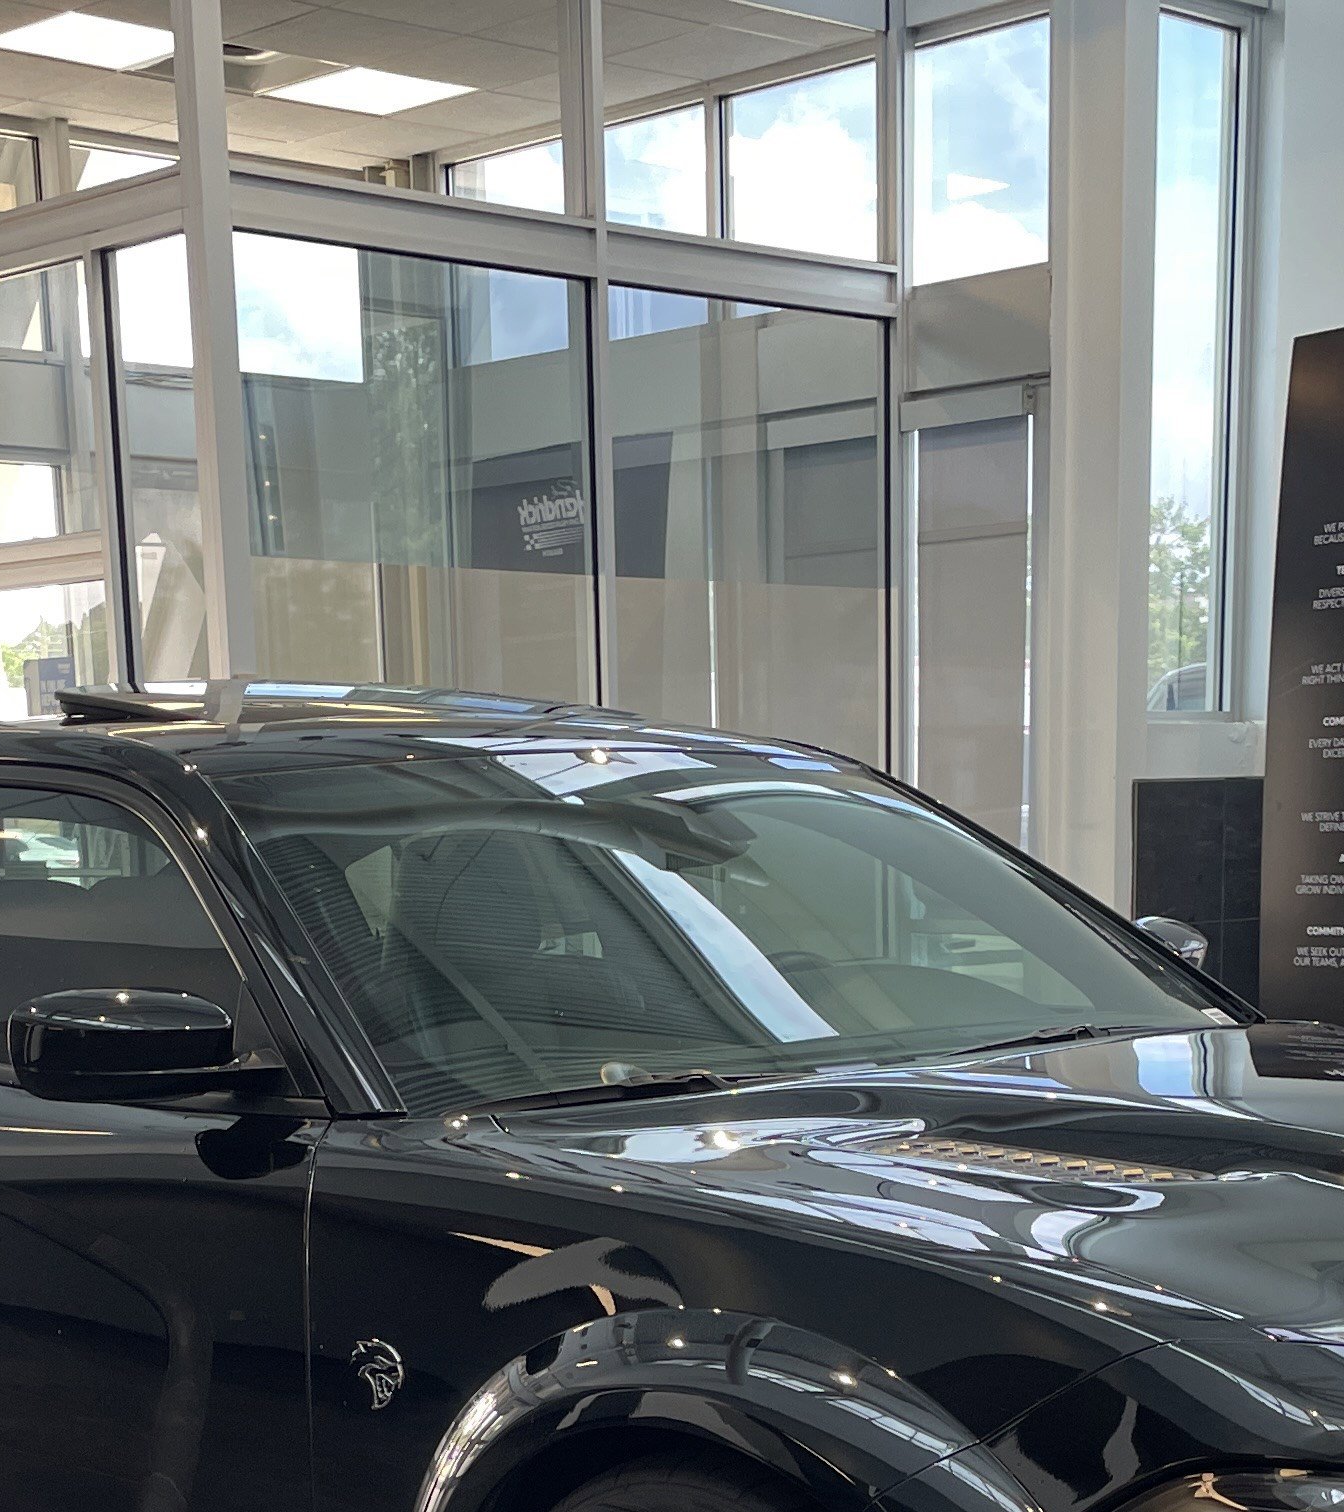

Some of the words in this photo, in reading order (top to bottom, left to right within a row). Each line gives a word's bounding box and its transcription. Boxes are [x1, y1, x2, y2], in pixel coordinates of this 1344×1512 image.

[1324, 522, 1336, 533] WE
[1313, 597, 1344, 610] RESPECT
[1311, 664, 1324, 674] WE
[1325, 663, 1341, 673] ACT
[1301, 674, 1325, 685] RIGHT
[1309, 738, 1332, 749] EVERY
[1301, 812, 1313, 822] WE
[1314, 812, 1340, 821] STRIVE
[1300, 874, 1328, 884] TAKING
[1295, 885, 1321, 895] GROW
[1296, 947, 1309, 957] WE
[1310, 947, 1328, 957] SEEK
[1293, 957, 1310, 967] OUR
